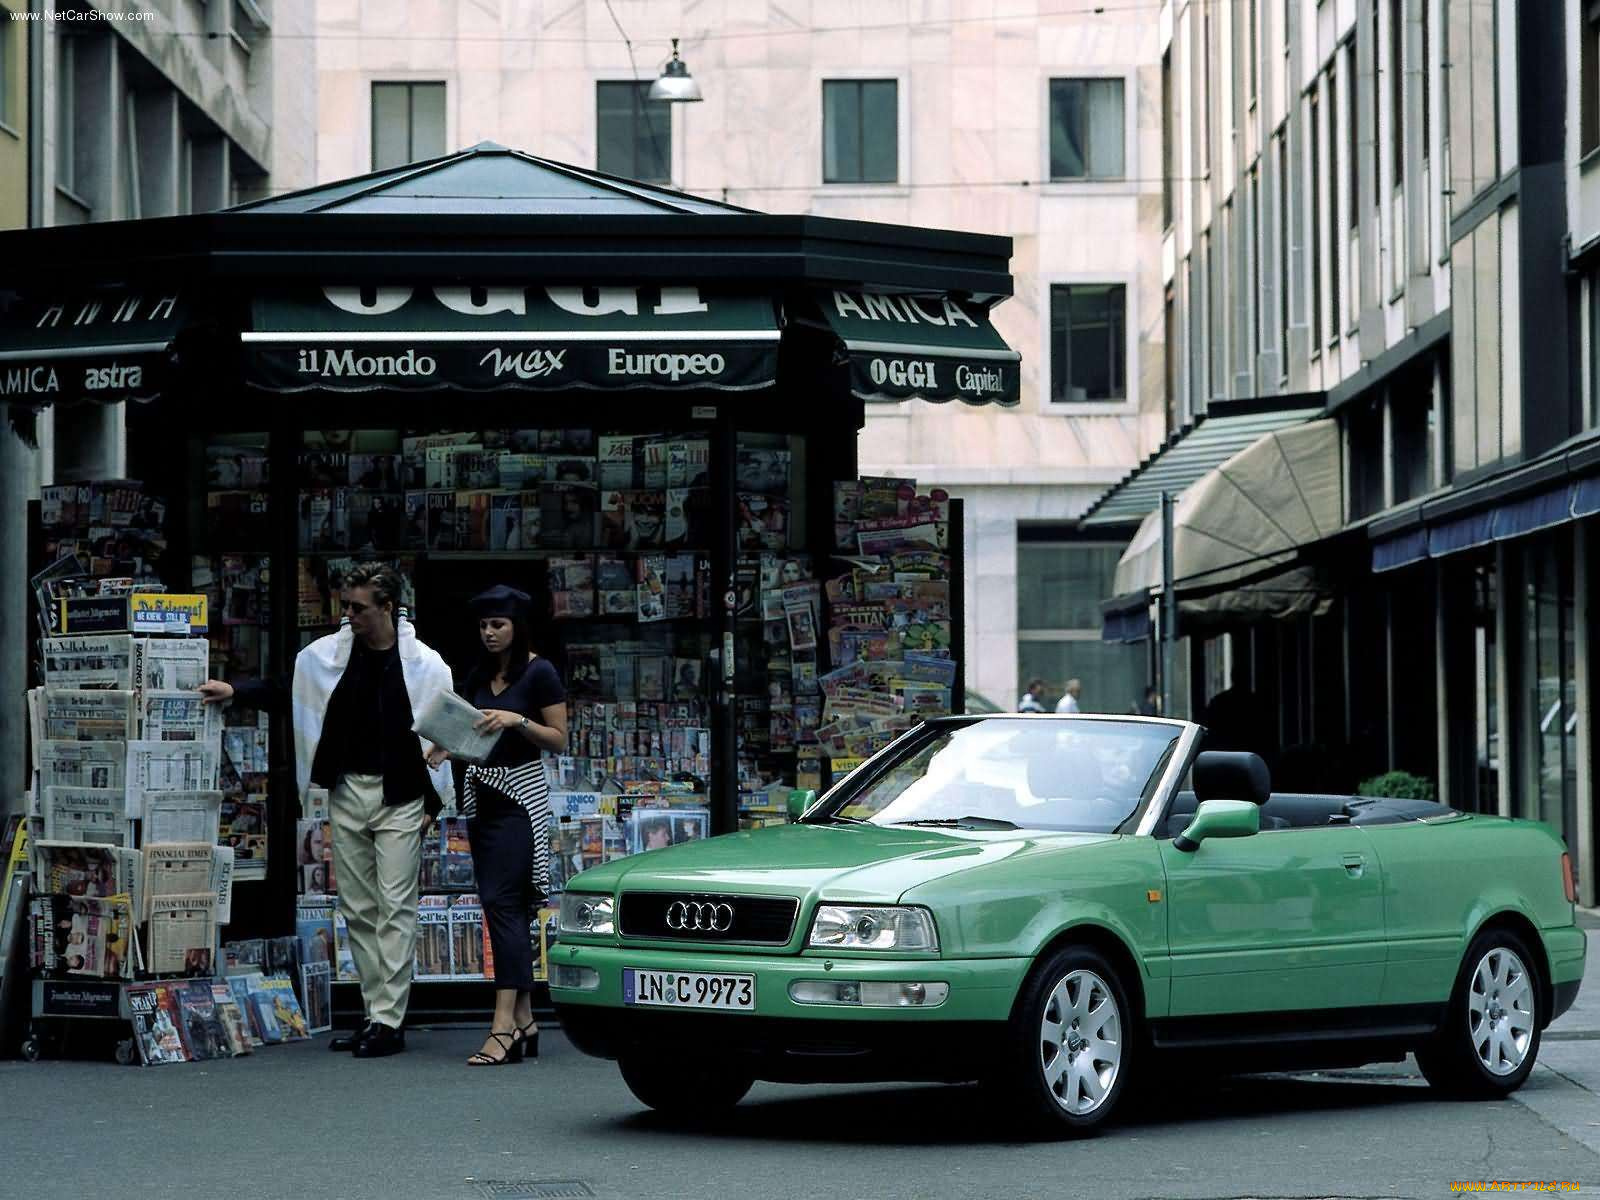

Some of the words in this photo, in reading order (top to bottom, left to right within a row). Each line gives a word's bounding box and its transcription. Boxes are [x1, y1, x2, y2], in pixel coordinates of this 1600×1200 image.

[84, 361, 143, 391] astra
[298, 350, 319, 373] il
[320, 350, 437, 377] Mondo
[607, 348, 725, 380] Europeo
[870, 358, 938, 389] OGGI
[956, 364, 1004, 396] Capital
[567, 795, 595, 803] UNICO
[638, 974, 663, 1001] IN
[677, 976, 691, 1003] C
[695, 977, 752, 1005] 9973
